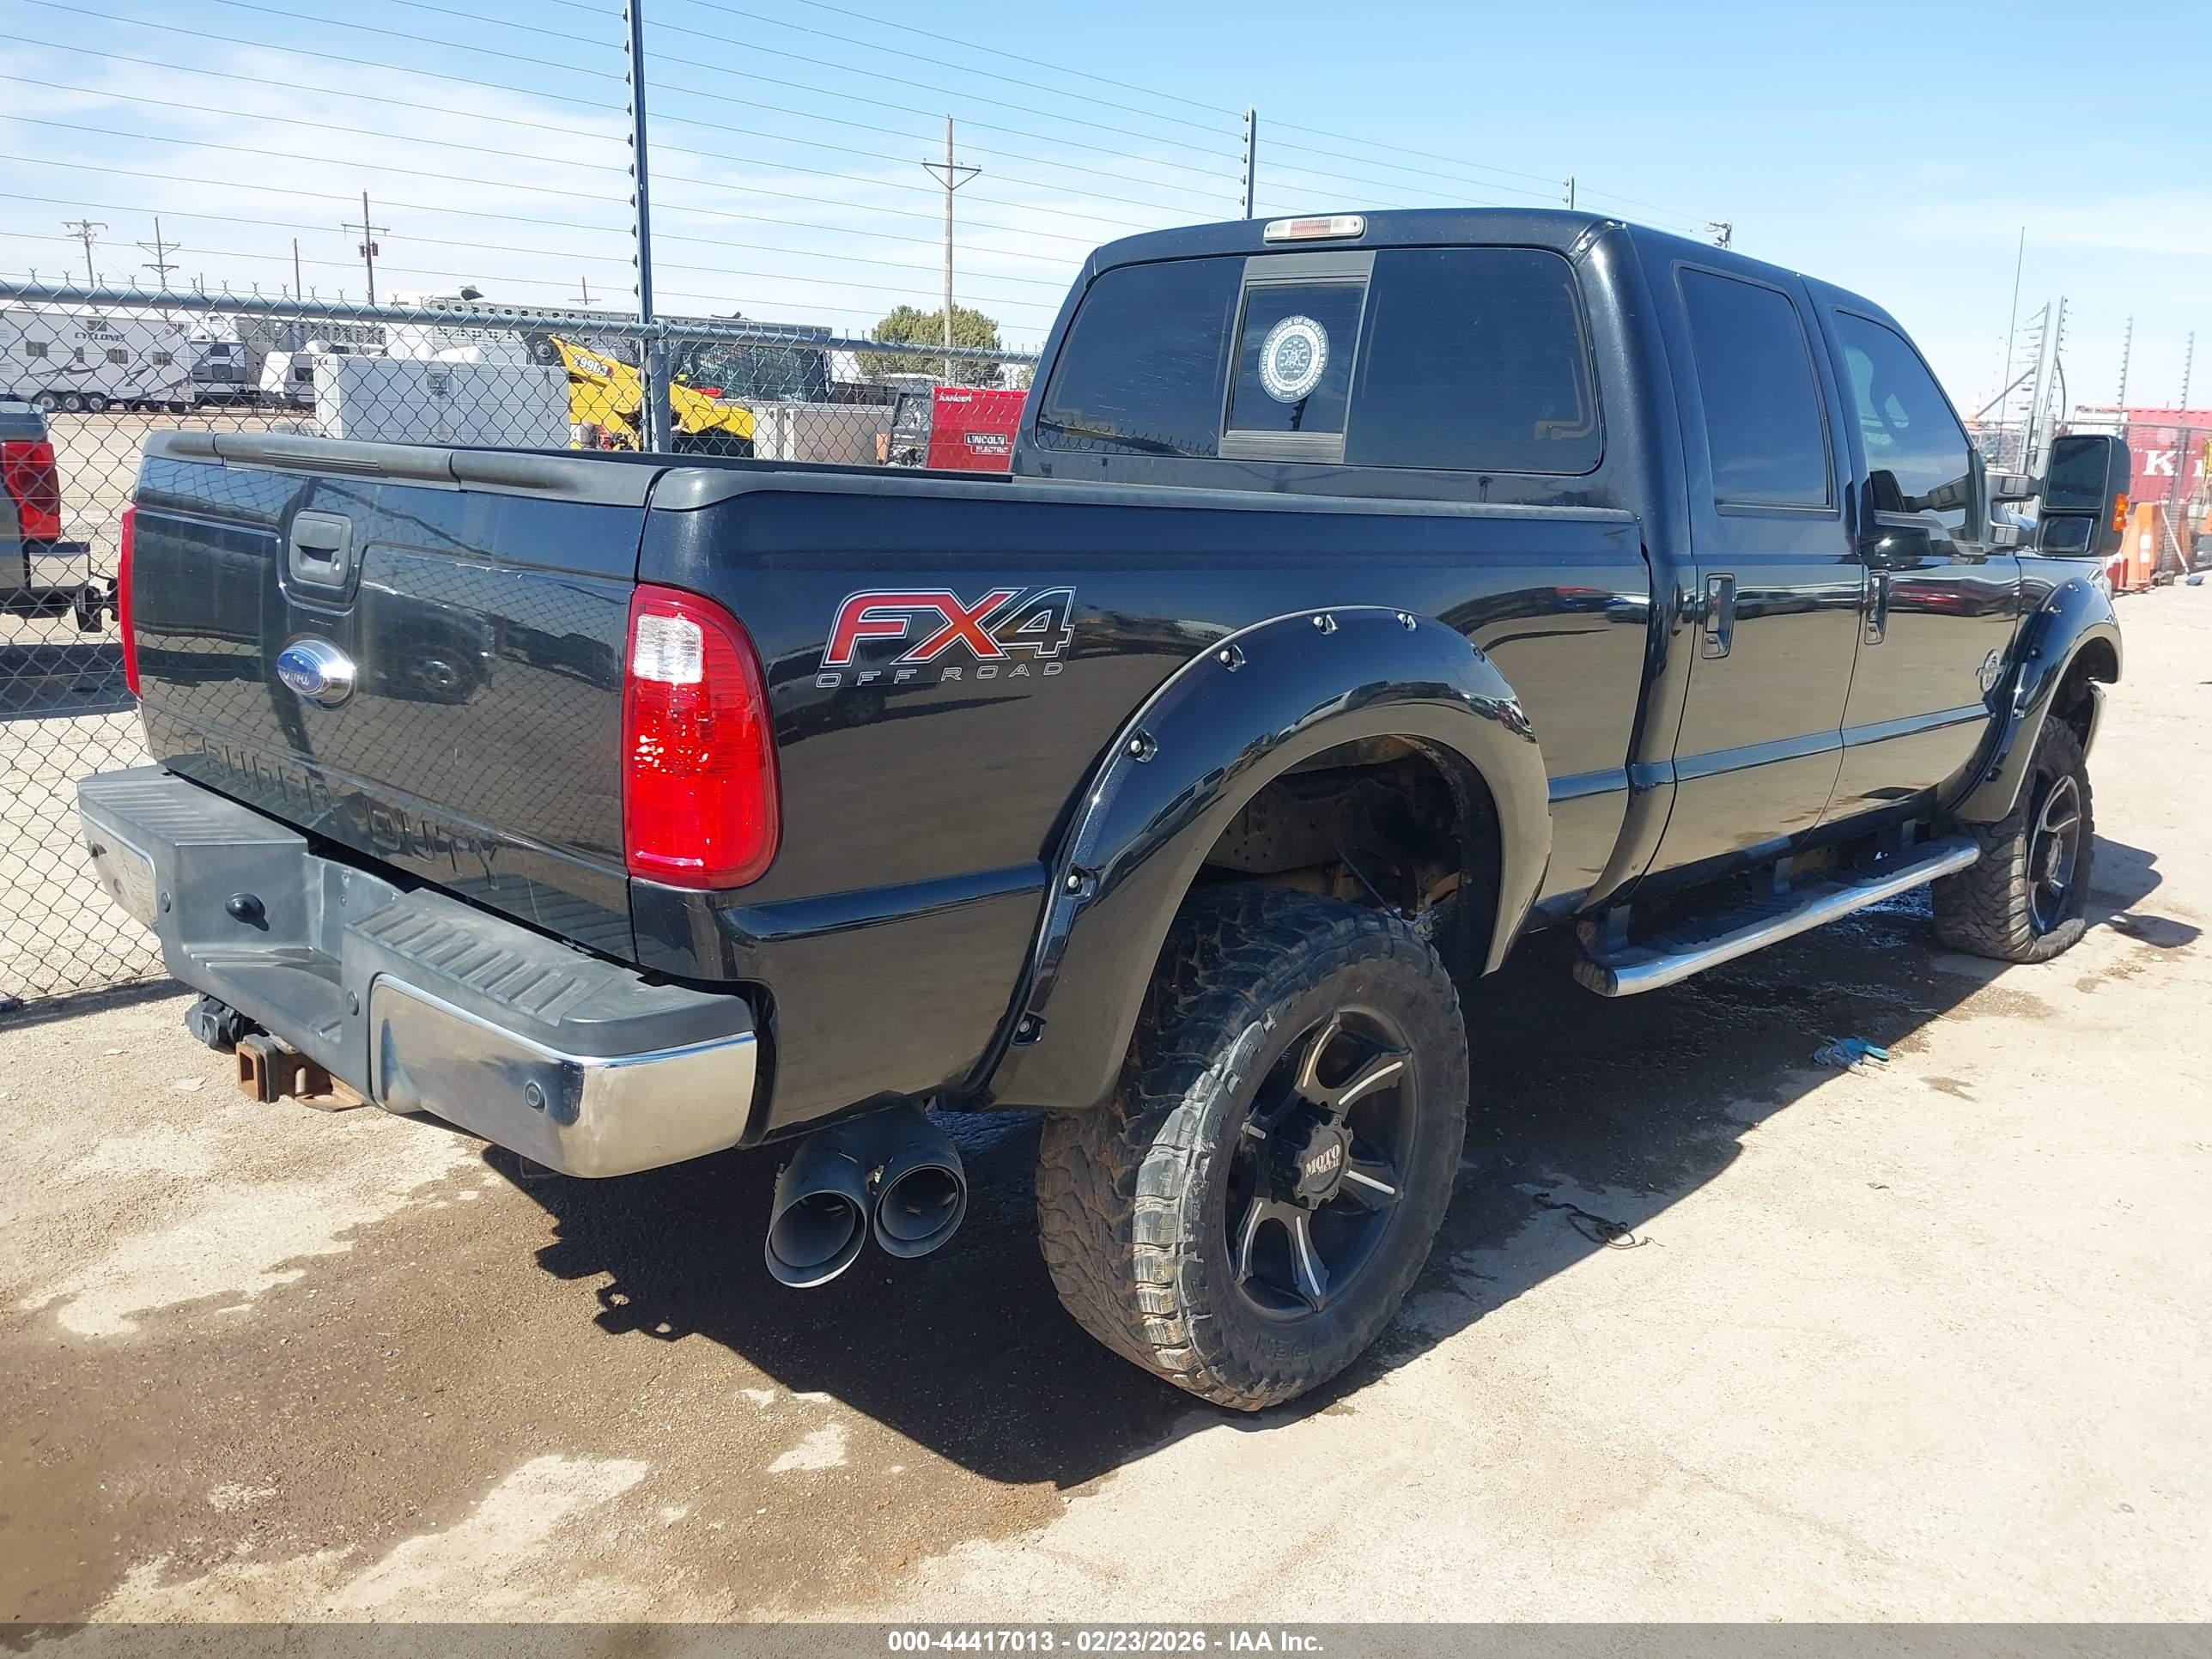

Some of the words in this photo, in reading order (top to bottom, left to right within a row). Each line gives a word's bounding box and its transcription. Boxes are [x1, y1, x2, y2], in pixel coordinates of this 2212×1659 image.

[74, 331, 125, 342] CYCLONE
[1272, 319, 1292, 338] UNION
[1293, 317, 1304, 325] OF
[1304, 319, 1327, 354] OPERATING
[1261, 340, 1282, 396] INTERNATIONAL
[1296, 356, 1326, 396] ENGINEERS
[967, 434, 1006, 445] LINCOLN
[820, 586, 1077, 668] FX4
[816, 669, 917, 688] OFF
[941, 662, 1064, 682] ROAD
[364, 797, 504, 891] DUTY
[1305, 1144, 1340, 1178] MOTO
